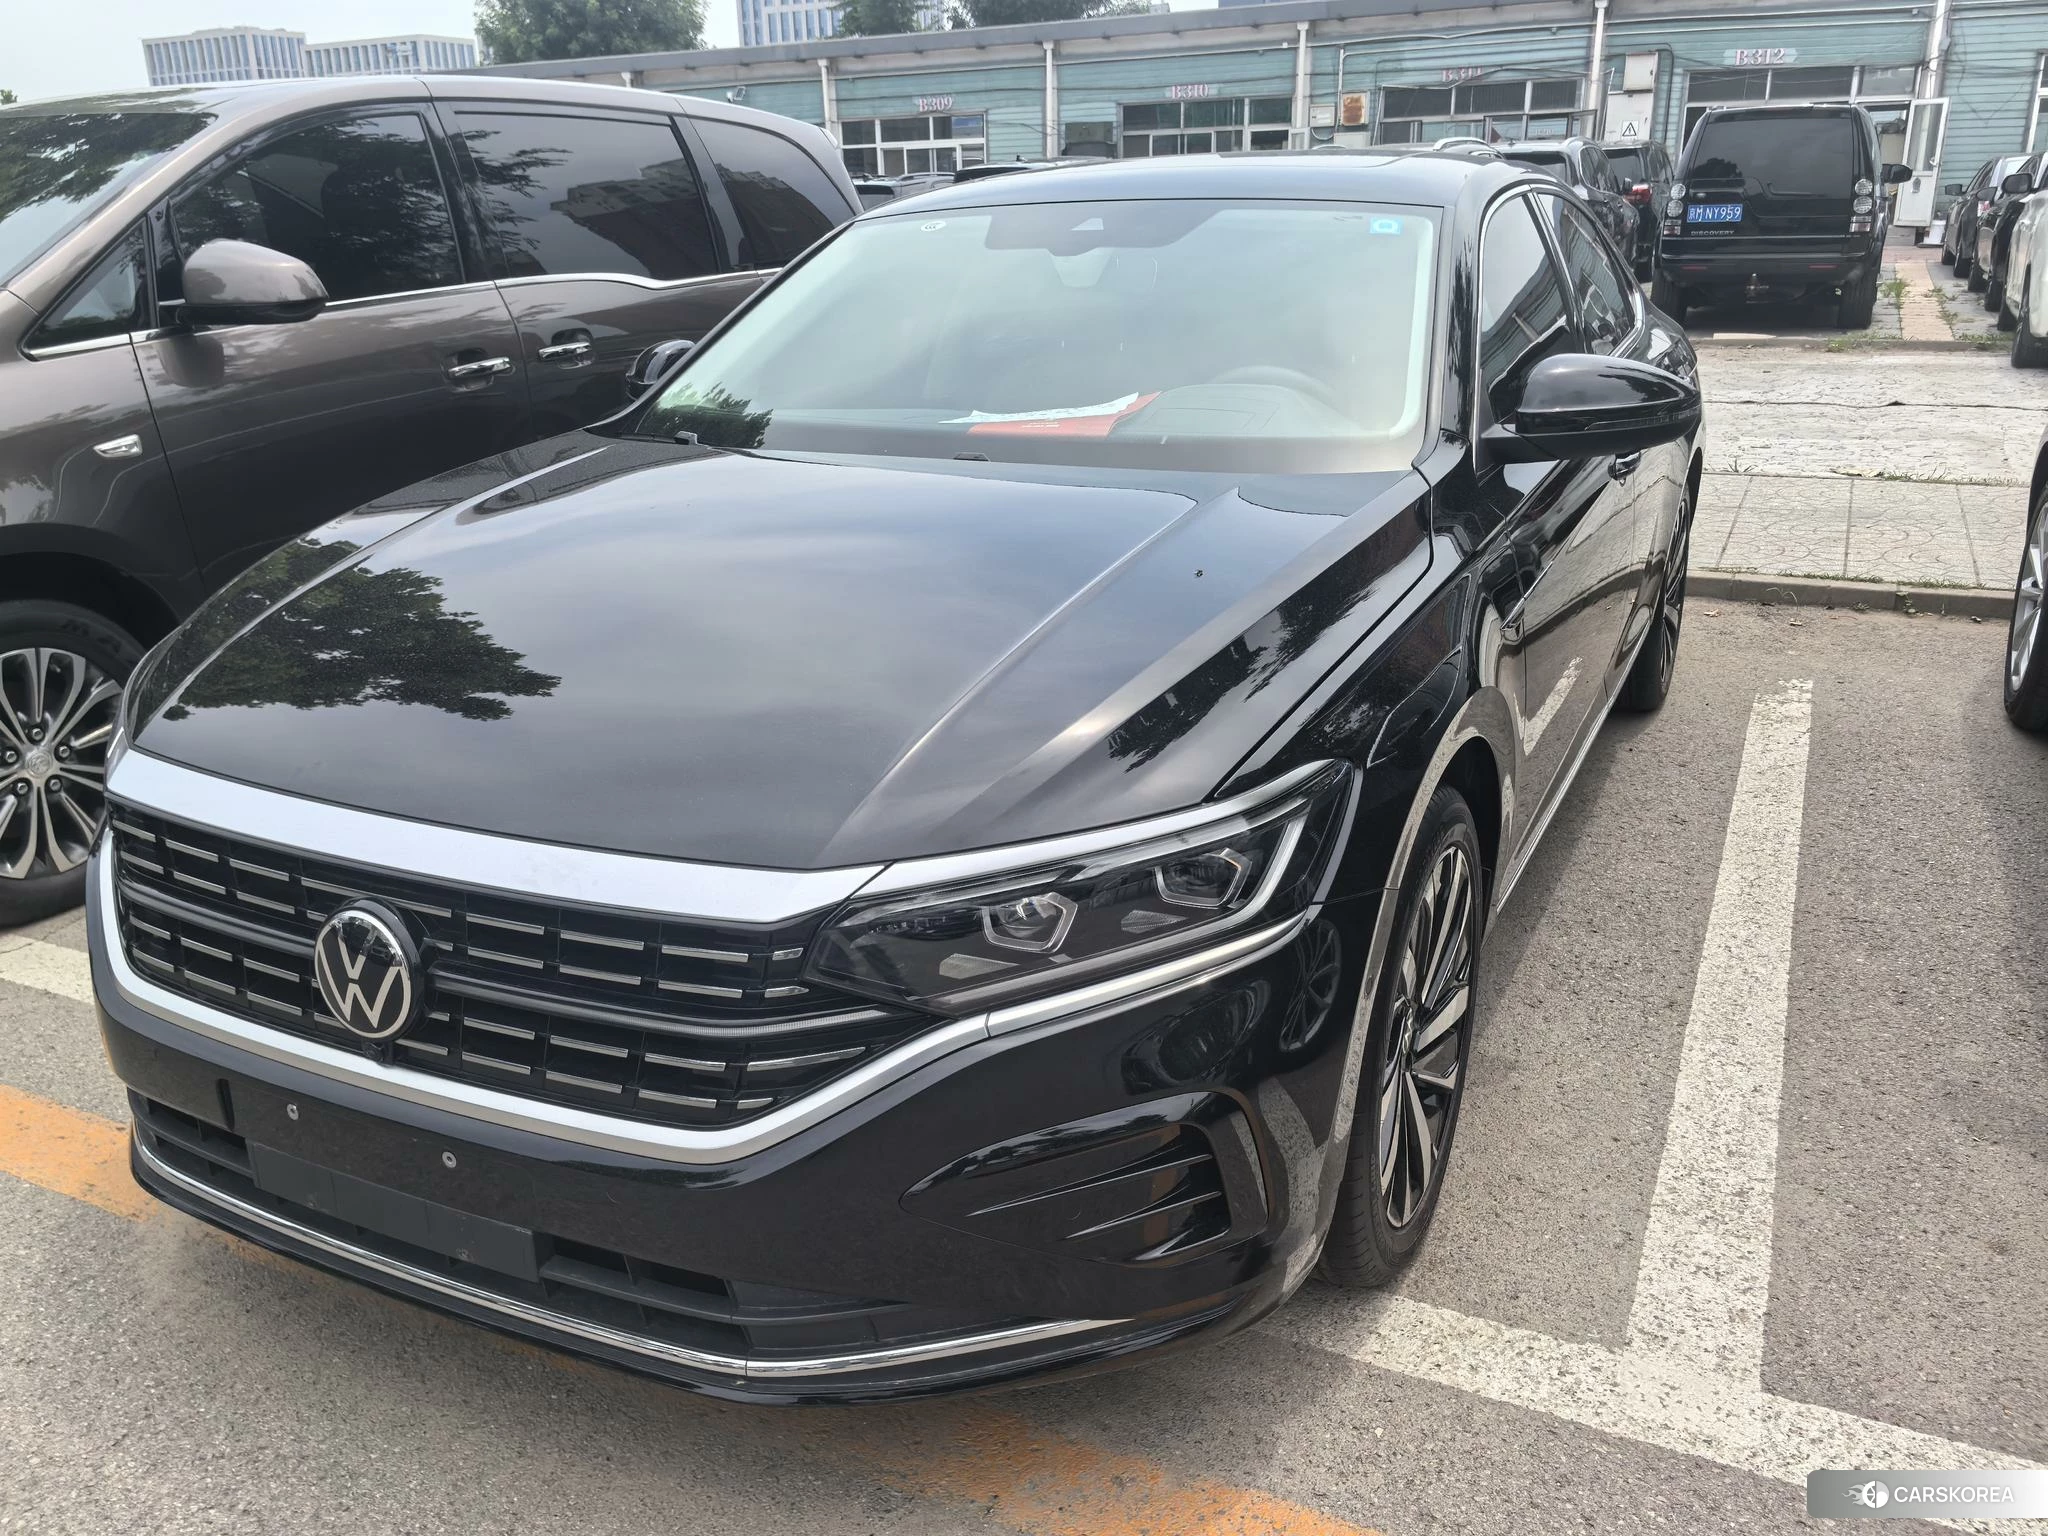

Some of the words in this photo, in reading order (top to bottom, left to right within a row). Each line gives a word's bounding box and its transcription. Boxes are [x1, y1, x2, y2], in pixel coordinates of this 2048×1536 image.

[1735, 48, 1785, 66] B312
[1171, 83, 1209, 99] B310
[919, 95, 953, 112] B309
